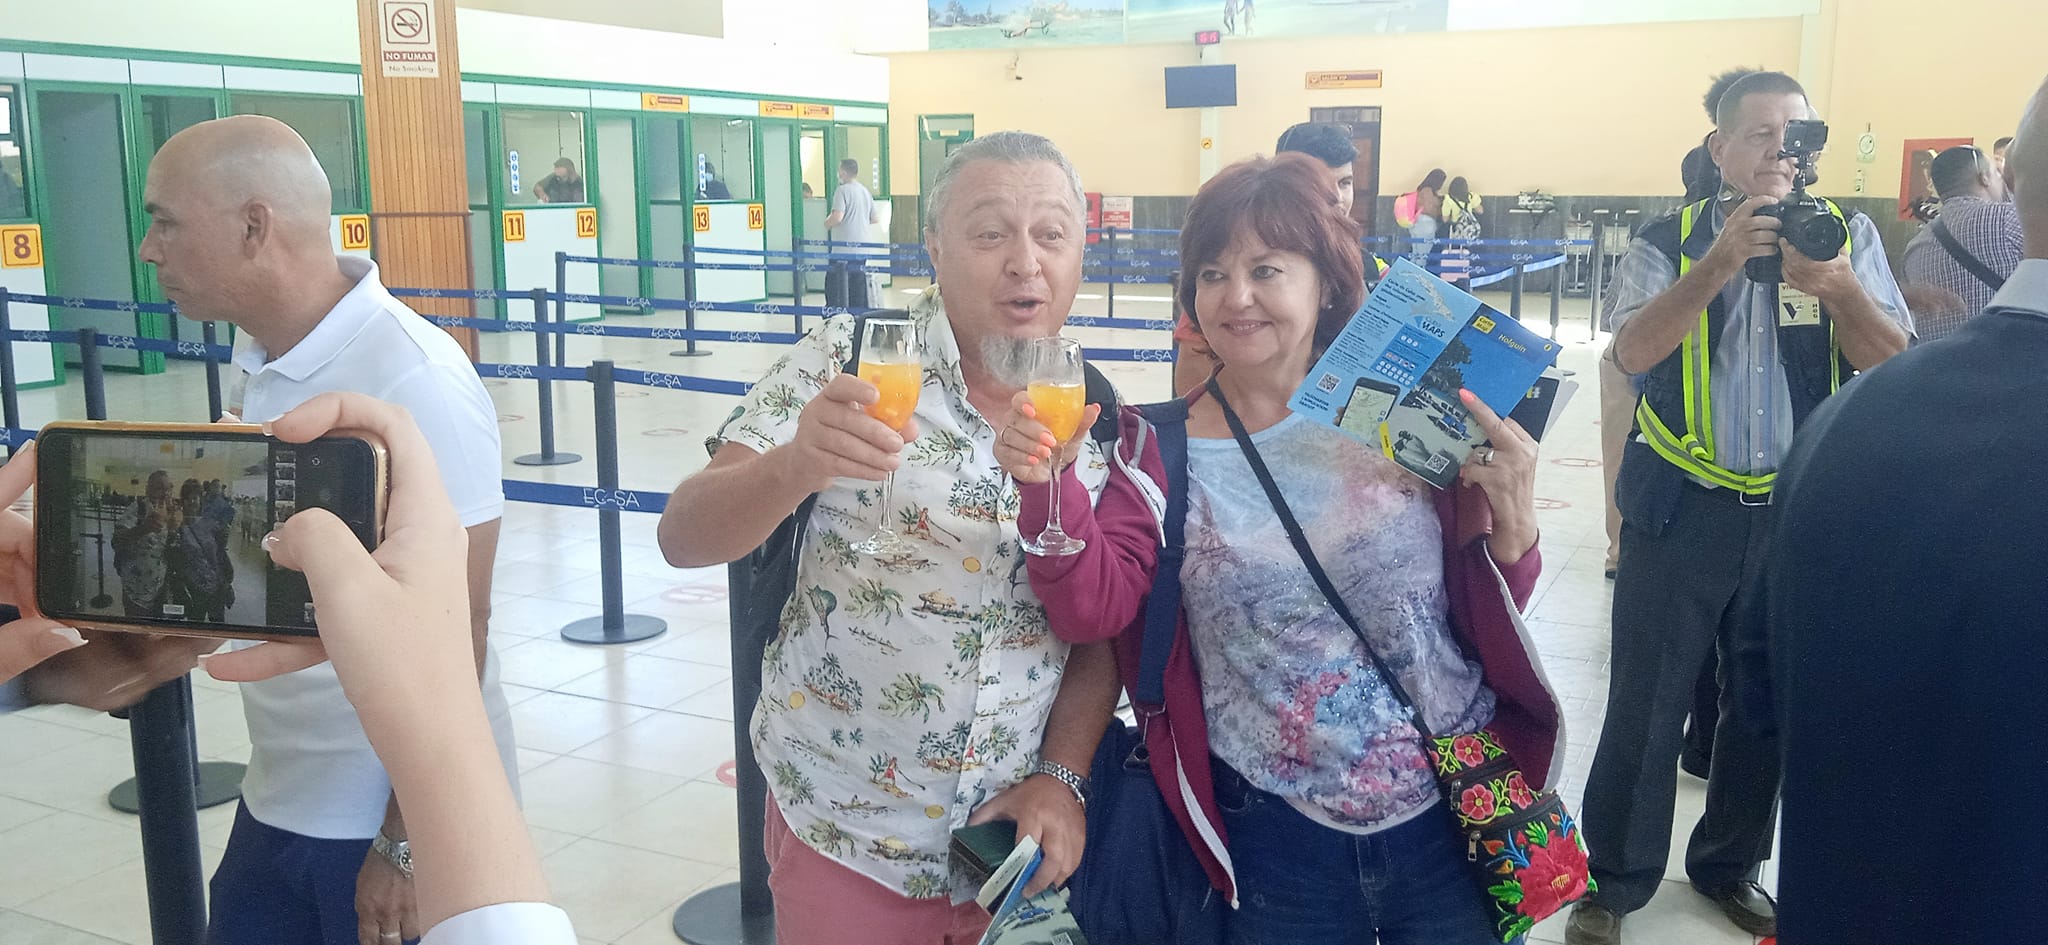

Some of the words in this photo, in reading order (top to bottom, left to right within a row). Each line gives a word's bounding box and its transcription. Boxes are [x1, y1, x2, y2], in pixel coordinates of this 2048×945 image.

[385, 52, 401, 61] NO
[402, 52, 433, 61] FUMAR
[579, 215, 594, 233] 12
[696, 211, 707, 228] 13
[750, 209, 762, 225] 14
[346, 223, 365, 244] 10
[507, 217, 522, 236] 11
[13, 233, 31, 259] 8
[1422, 321, 1446, 338] MAPS
